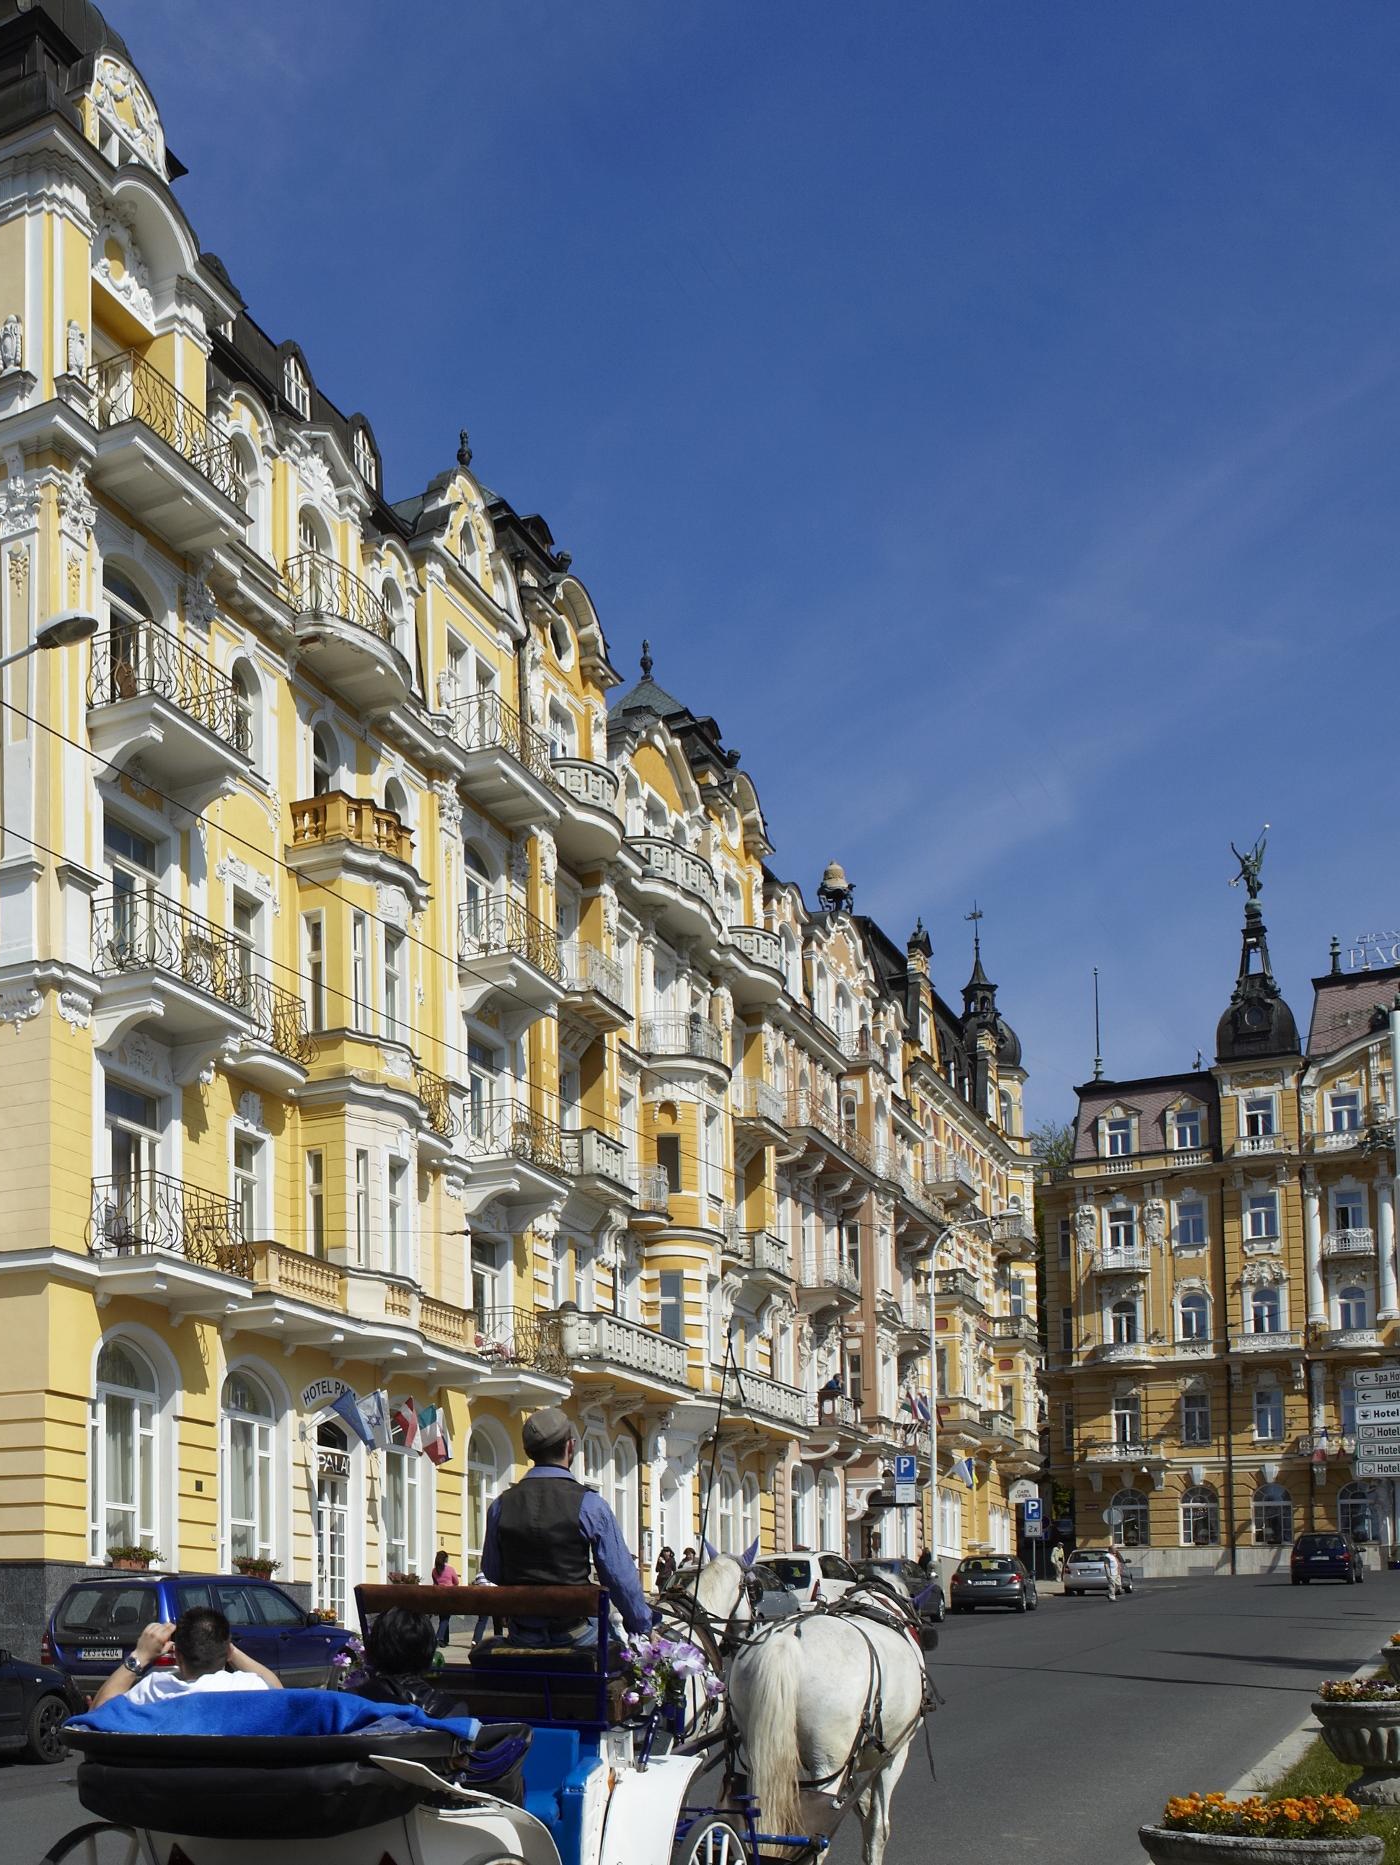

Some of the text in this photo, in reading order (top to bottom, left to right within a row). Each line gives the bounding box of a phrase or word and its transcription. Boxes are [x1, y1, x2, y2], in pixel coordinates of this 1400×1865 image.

[1375, 1372, 1388, 1382] Spa
[303, 1380, 332, 1405] HOTEL
[1373, 1408, 1400, 1418] Hotel
[900, 1458, 910, 1473] P
[1028, 1501, 1039, 1514] P
